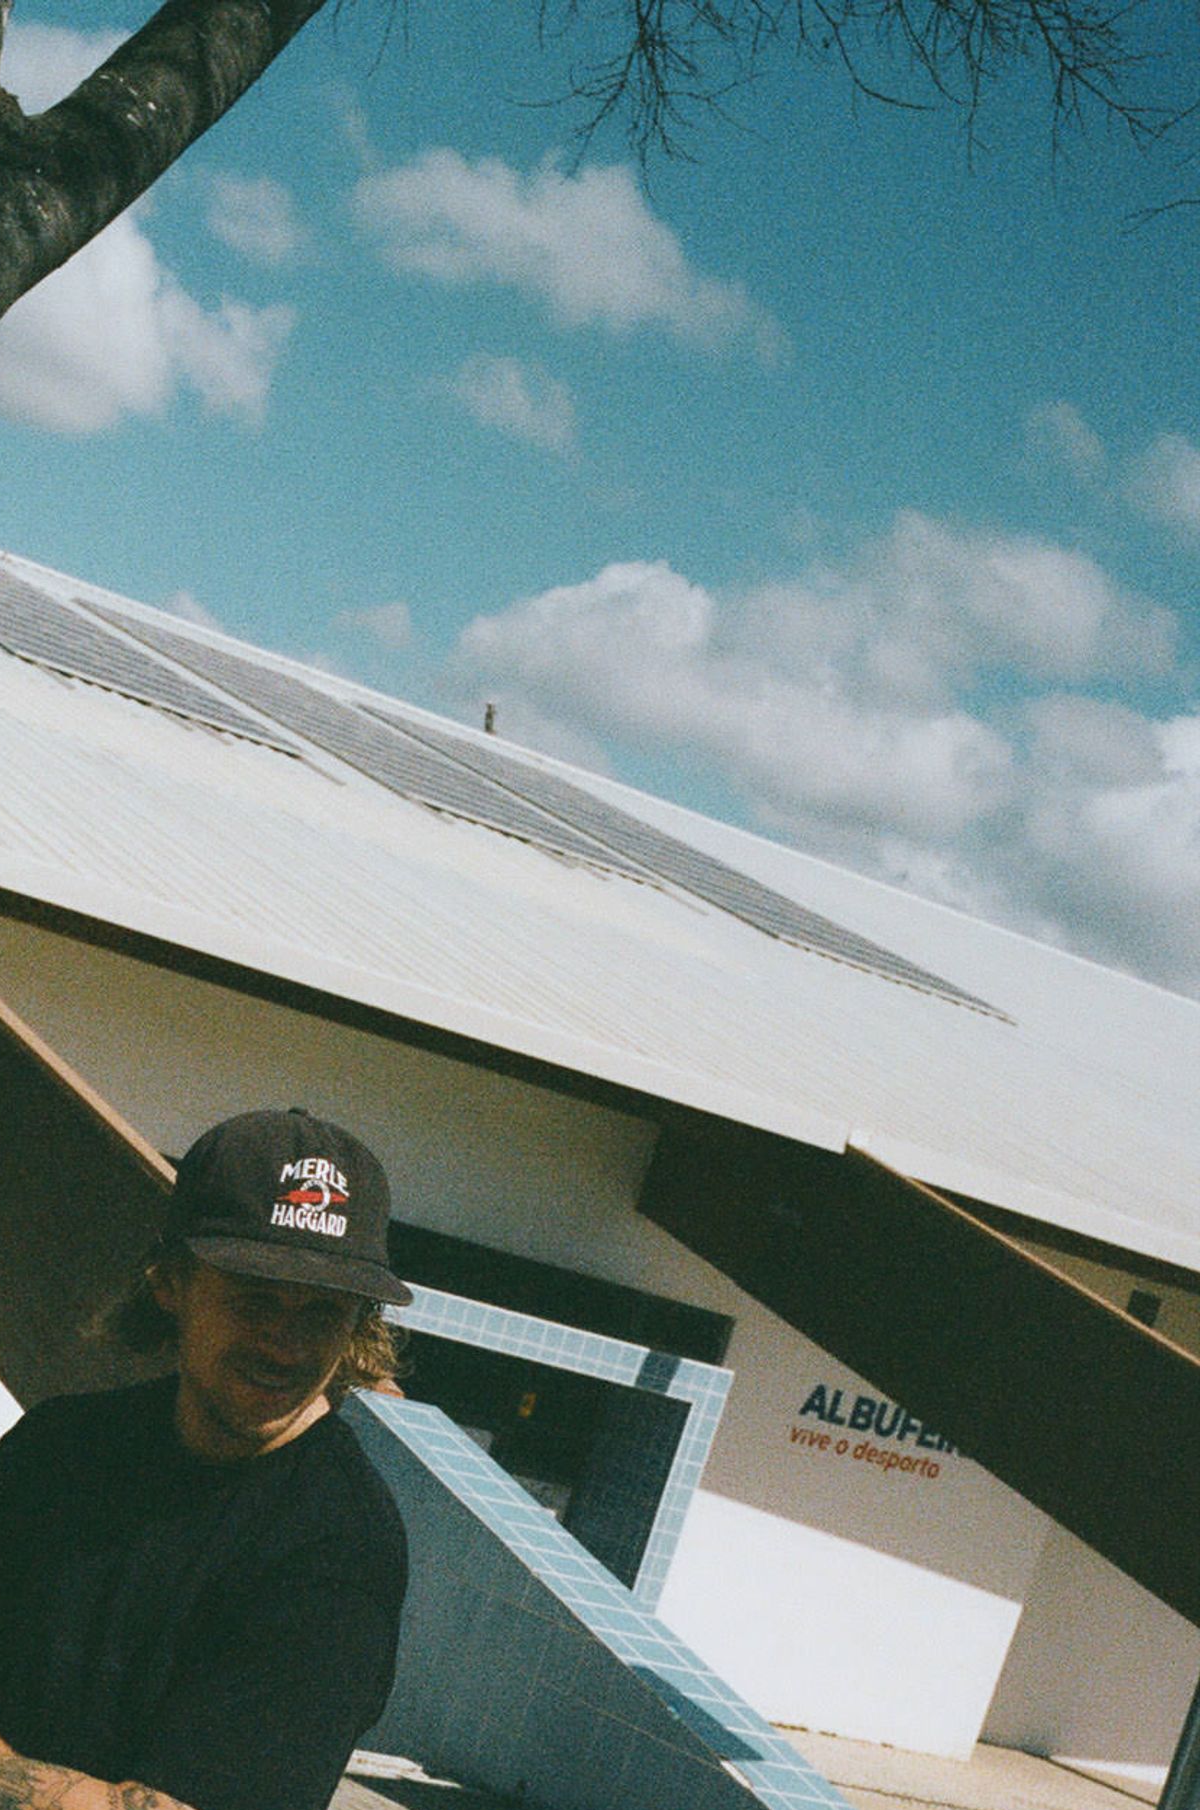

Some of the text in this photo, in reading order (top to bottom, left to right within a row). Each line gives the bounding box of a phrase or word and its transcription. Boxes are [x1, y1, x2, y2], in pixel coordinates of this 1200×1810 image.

[280, 1157, 350, 1198] MERLE
[270, 1202, 347, 1237] HAGGARD
[799, 1383, 956, 1454] ALBUFE
[790, 1426, 831, 1451] vive
[835, 1438, 849, 1455] o
